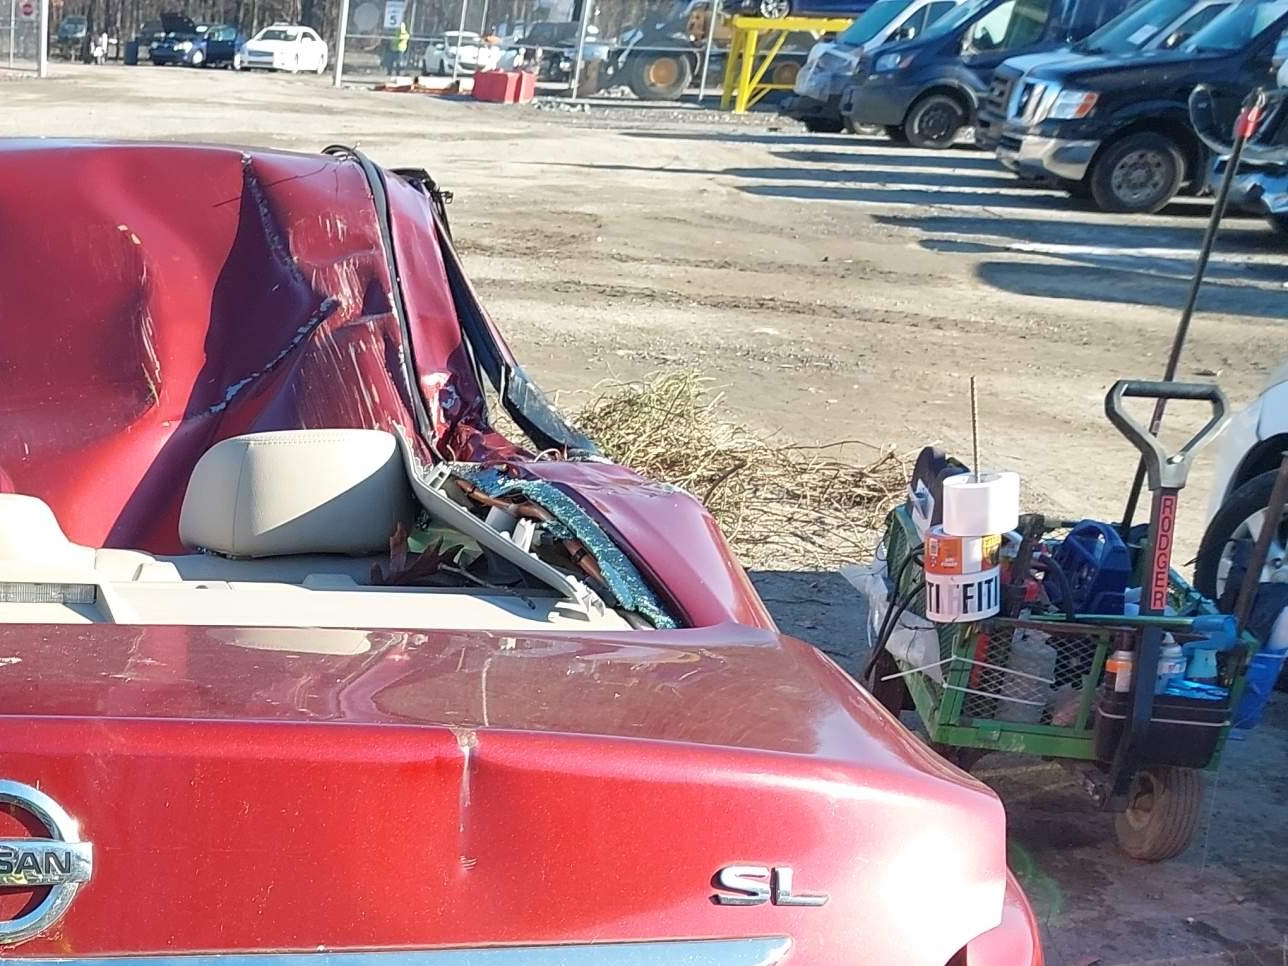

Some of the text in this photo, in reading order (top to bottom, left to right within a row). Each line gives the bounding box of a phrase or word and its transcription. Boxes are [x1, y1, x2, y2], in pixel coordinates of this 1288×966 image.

[389, 15, 397, 26] 5
[1153, 498, 1174, 607] RODGER
[957, 575, 999, 615] FITI
[709, 865, 829, 907] SL
